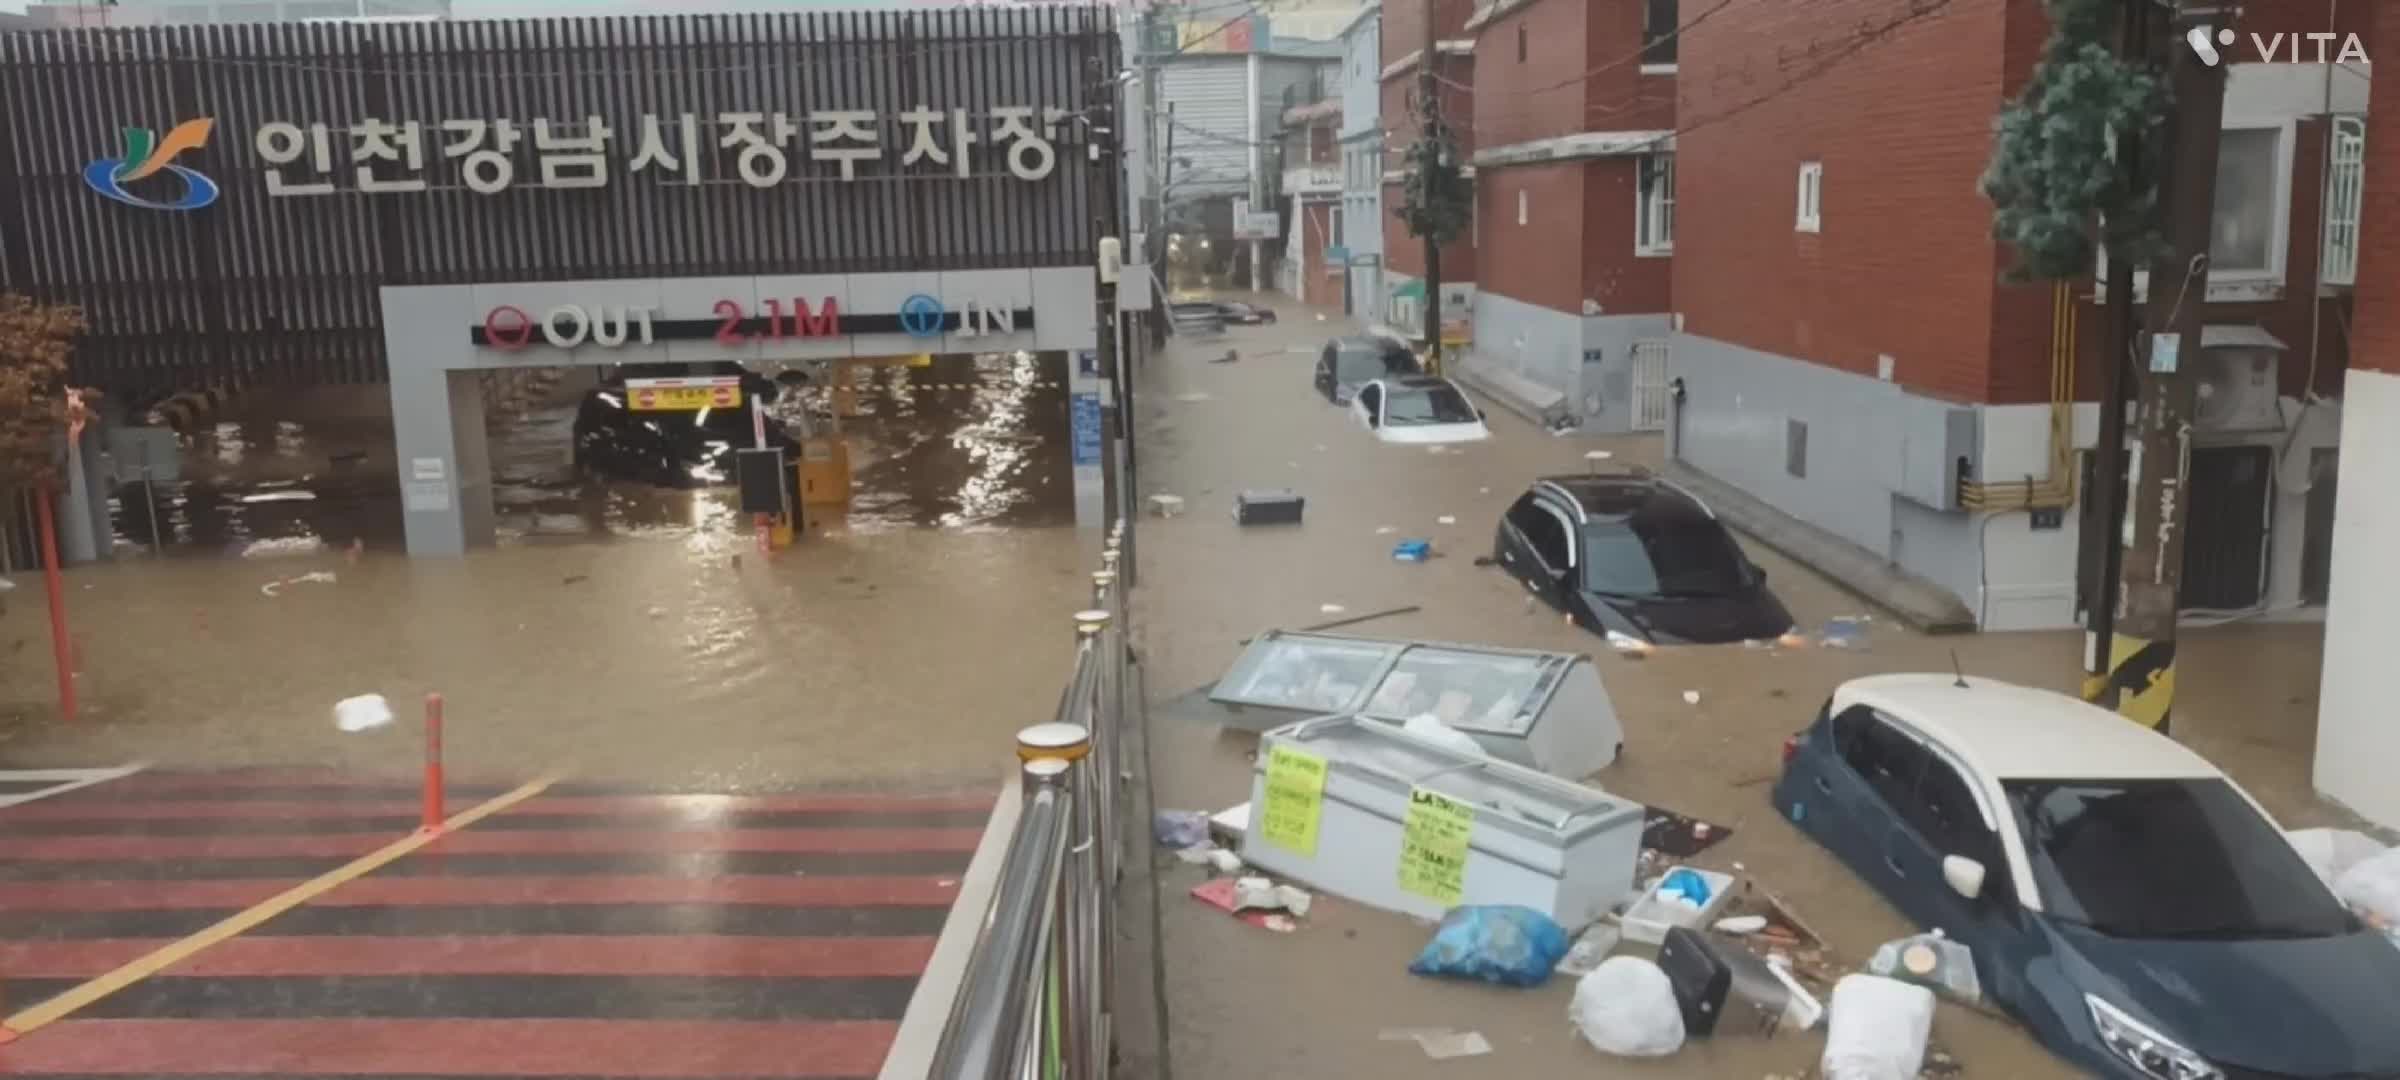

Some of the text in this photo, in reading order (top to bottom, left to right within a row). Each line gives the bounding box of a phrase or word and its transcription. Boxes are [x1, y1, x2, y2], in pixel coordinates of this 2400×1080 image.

[255, 104, 1058, 197] 인천강남시장주차장
[541, 295, 1016, 348] OUT 2.1M IN
